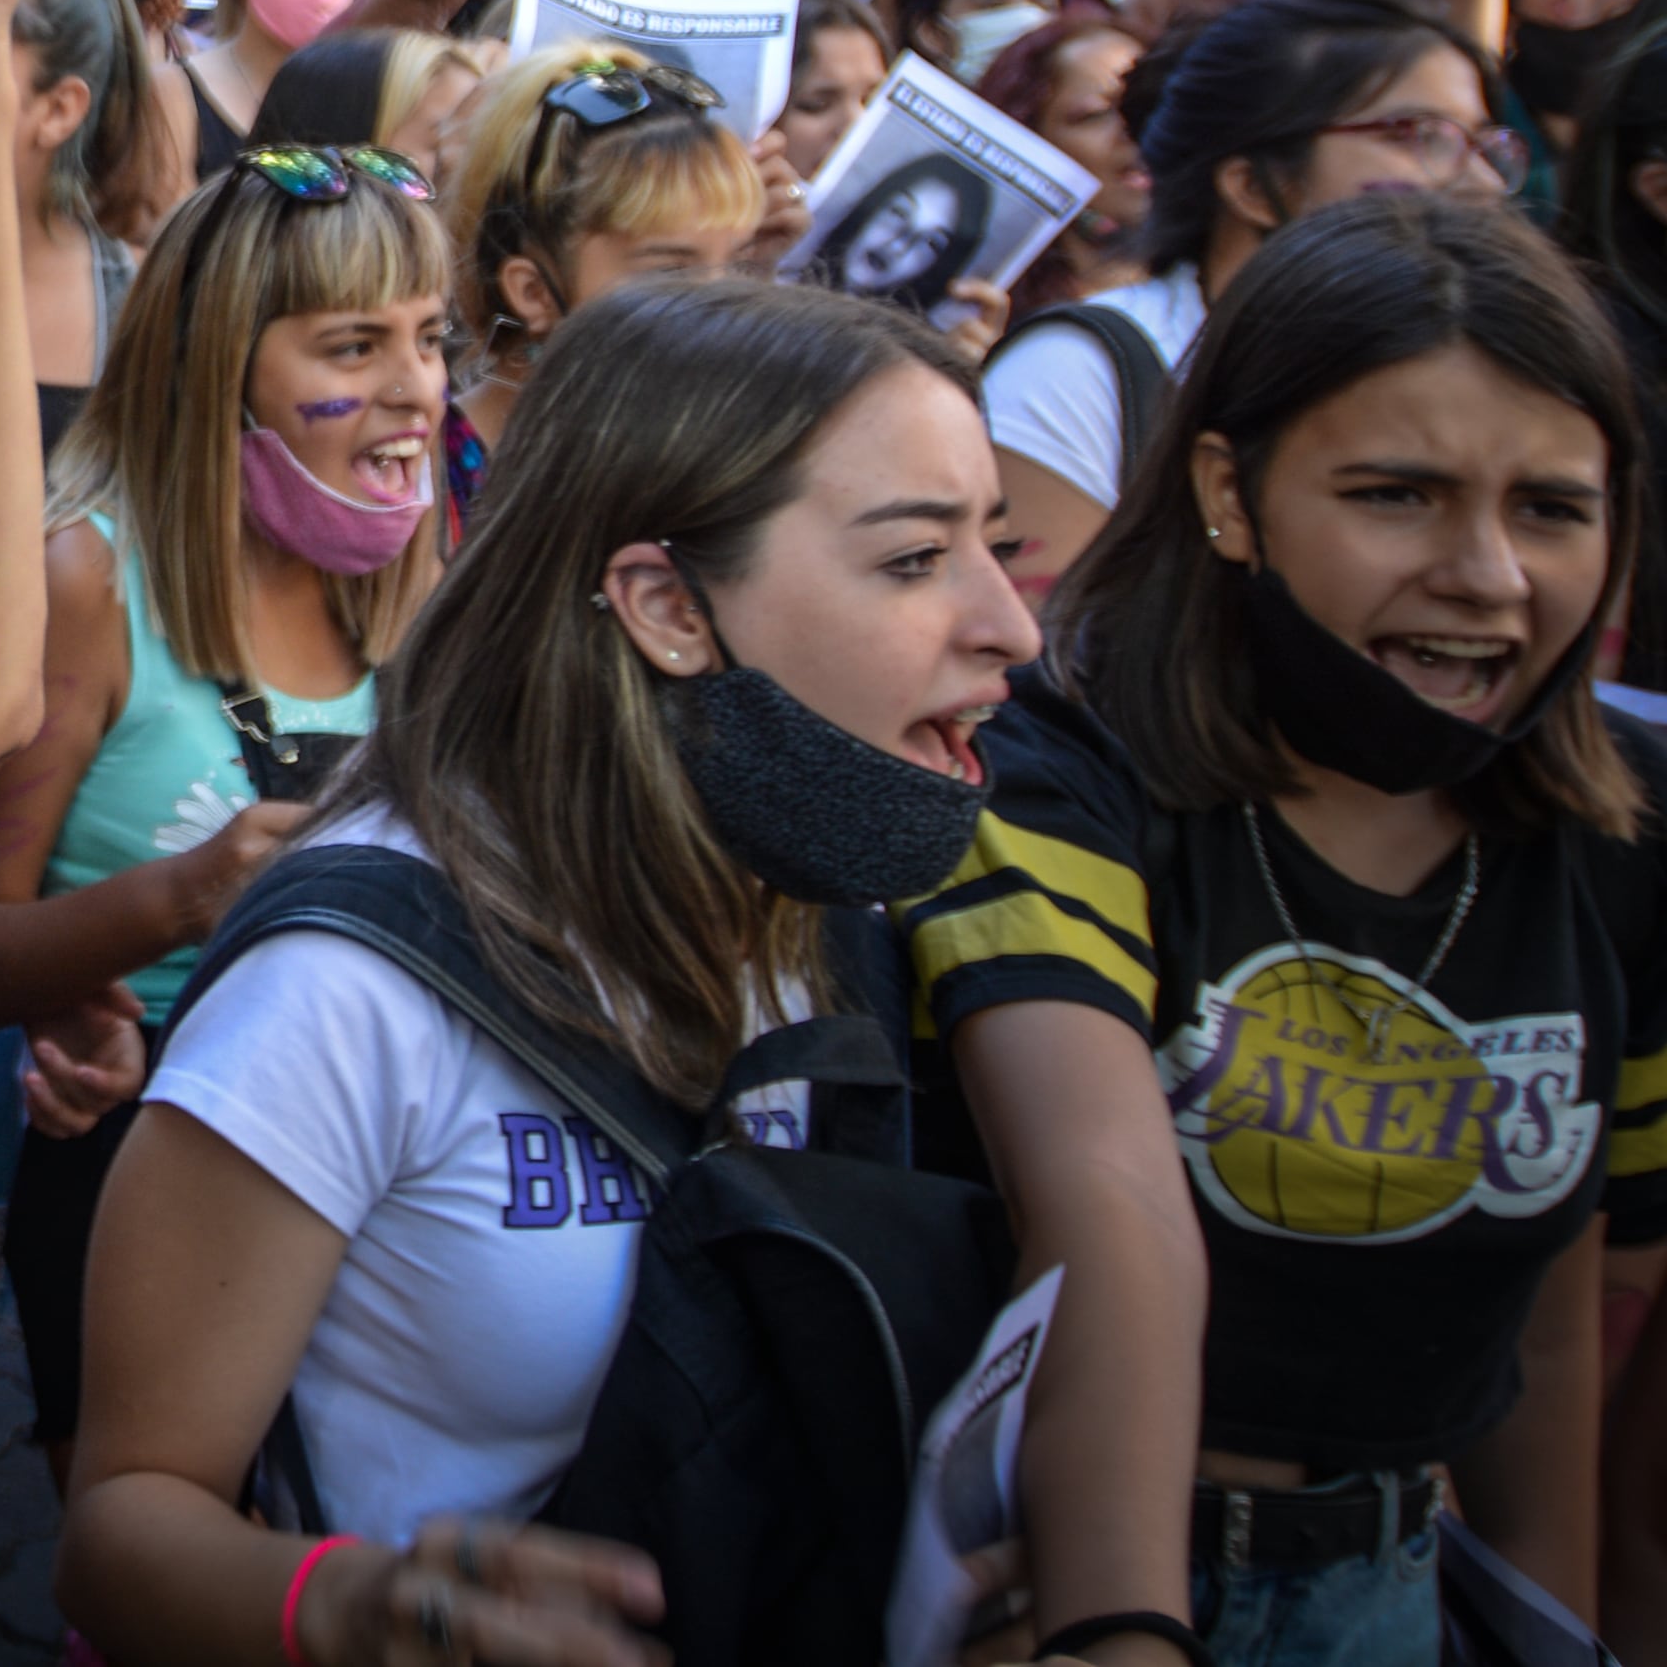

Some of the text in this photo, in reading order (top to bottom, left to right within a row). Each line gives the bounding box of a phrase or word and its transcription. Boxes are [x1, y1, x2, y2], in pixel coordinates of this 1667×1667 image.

[621, 12, 646, 30] ES
[648, 15, 780, 34] RESPONSABLE
[1278, 1017, 1352, 1058] LOS
[1167, 998, 1579, 1192] LAKERS
